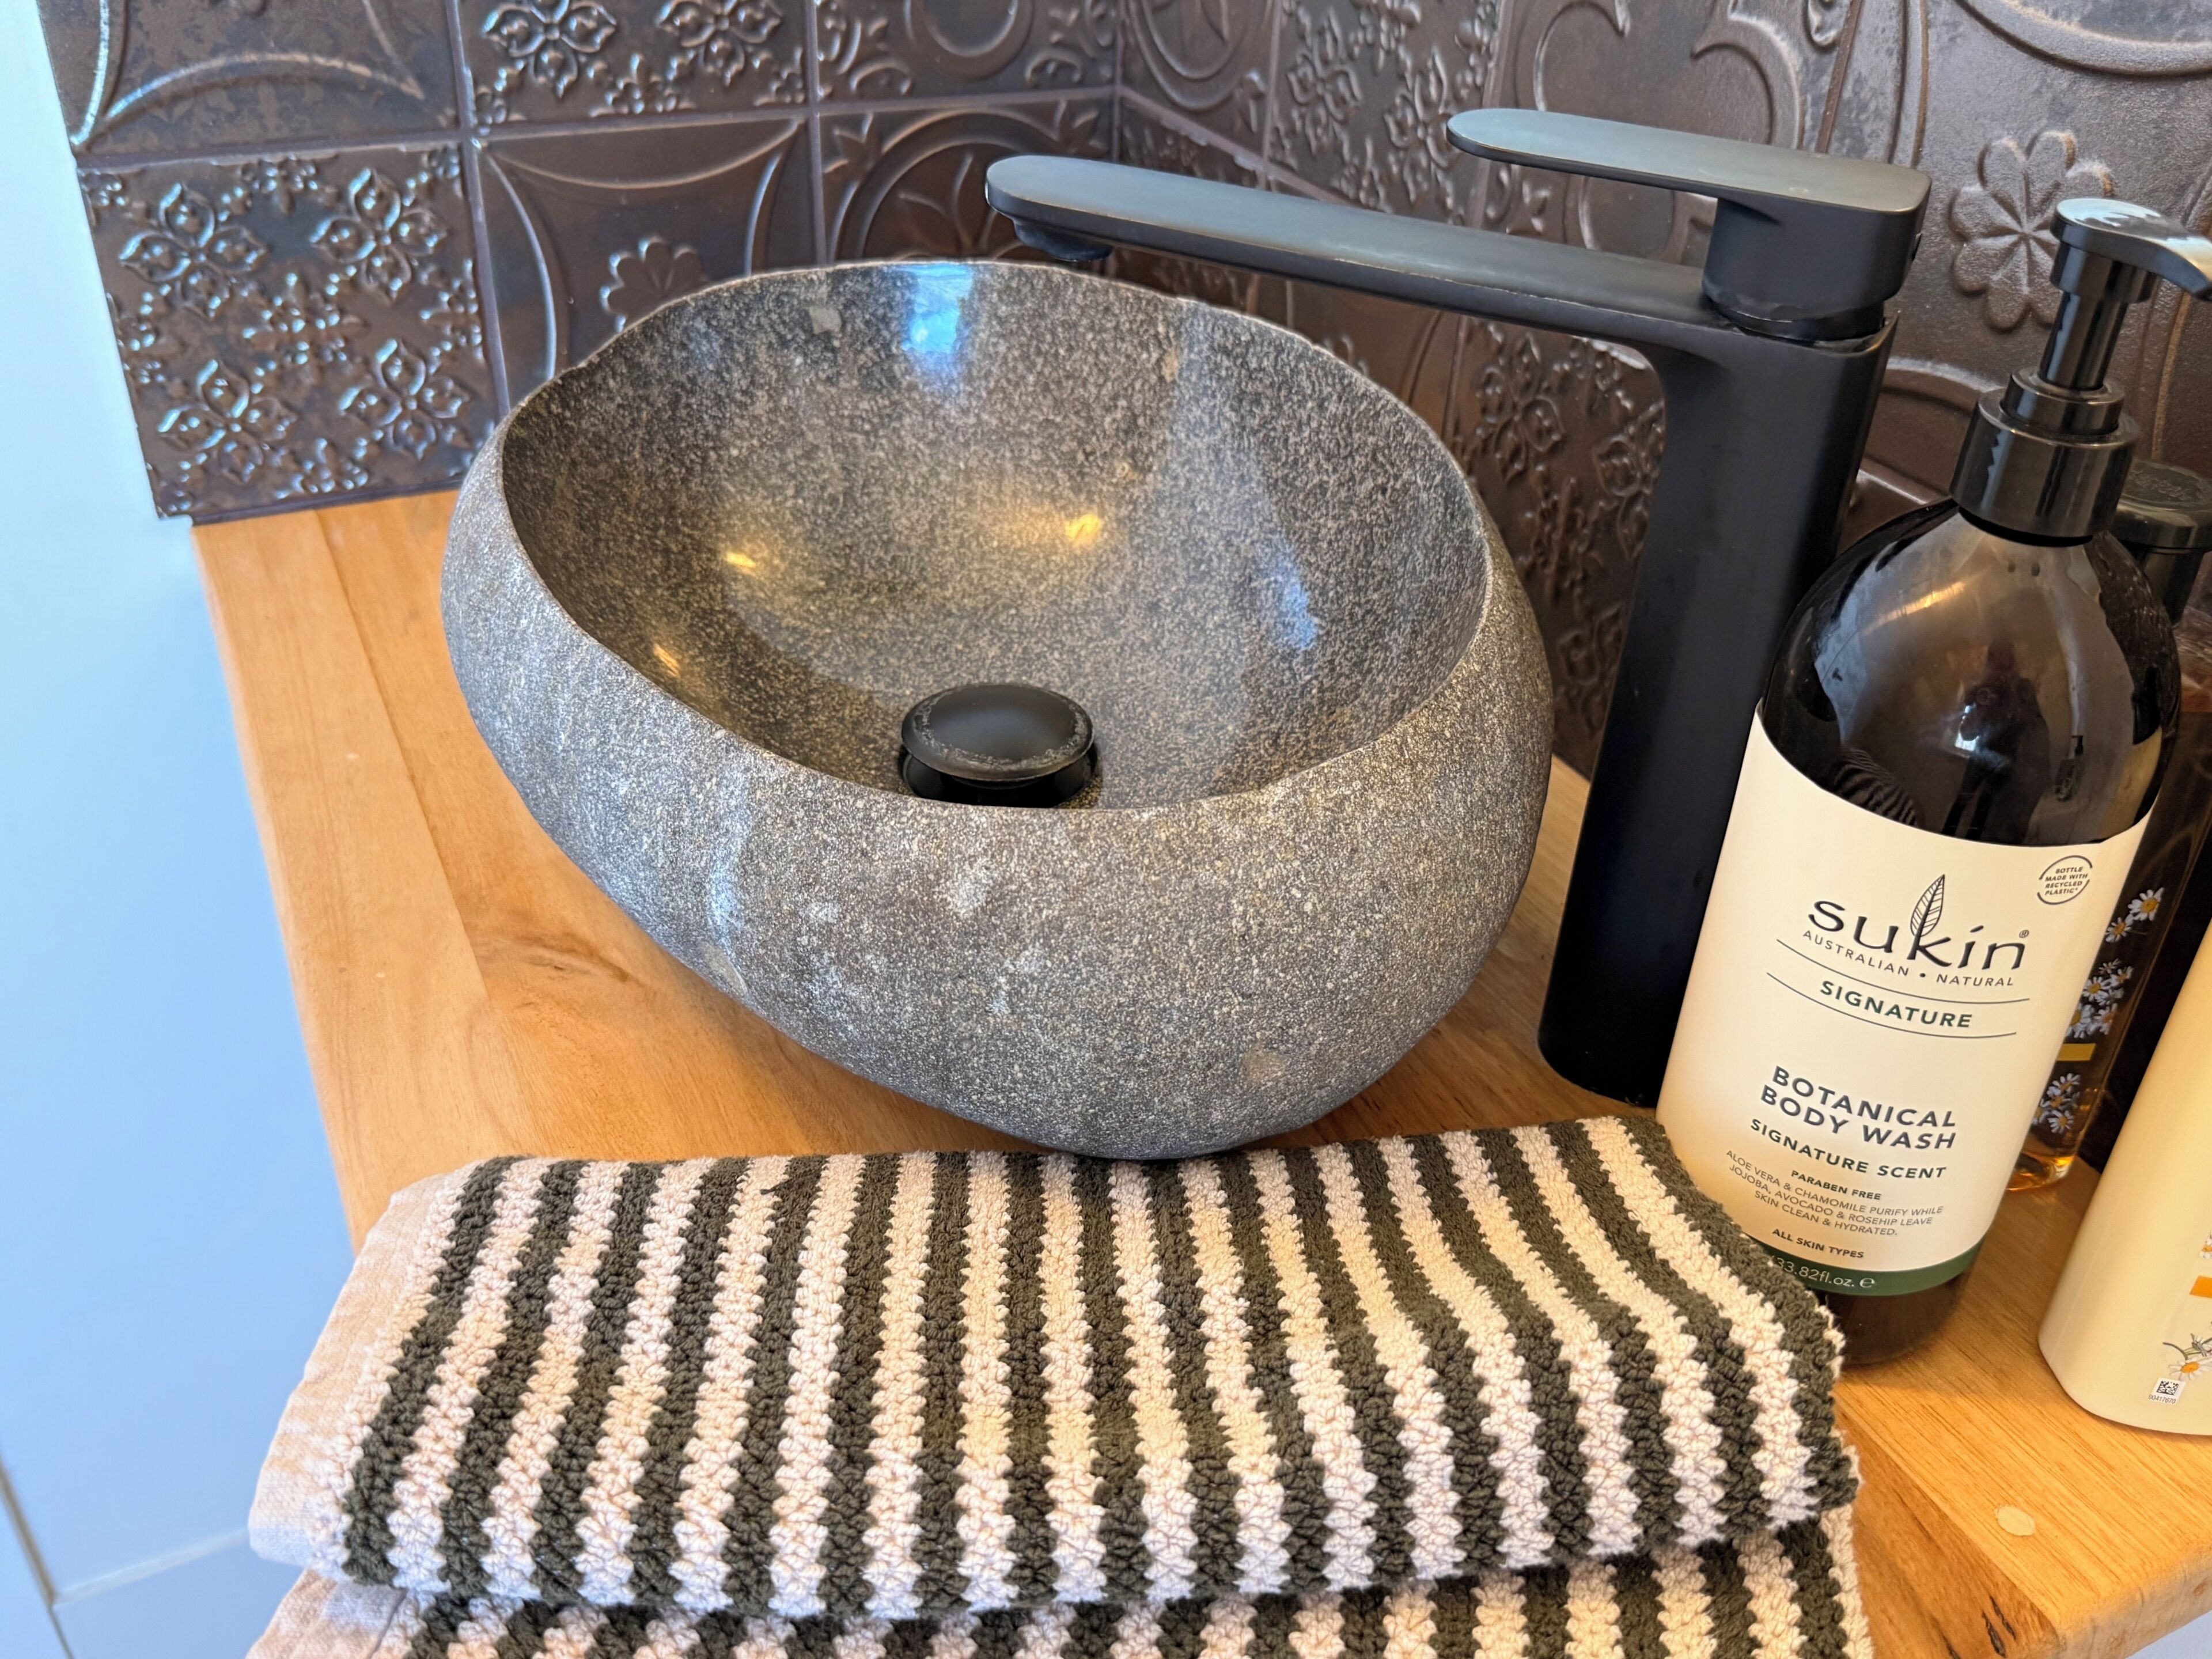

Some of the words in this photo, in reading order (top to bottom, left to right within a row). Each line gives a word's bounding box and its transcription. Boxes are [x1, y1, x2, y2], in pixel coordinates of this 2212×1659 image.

[1803, 930, 1909, 976] AUSTRALIAN
[1936, 973, 2014, 987] NATURAL
[1820, 981, 1972, 1028] SIGNATURE
[1760, 1085, 1849, 1134] BODY
[1862, 1124, 1956, 1149] WASH
[1772, 1066, 1956, 1127] BOTANICAL
[1751, 1119, 1869, 1173] SIGNATURE
[1877, 1165, 1946, 1179] SCENT
[1726, 1150, 1752, 1171] ALOE
[1755, 1166, 1780, 1186] VERA
[1783, 1183, 1791, 1191] &
[1795, 1187, 1866, 1213] CHAMOMILE
[1869, 1206, 1908, 1217] PURIFY
[1911, 1206, 1944, 1216] WHILE
[1729, 1164, 1771, 1194] JOJOBA,
[1775, 1190, 1833, 1216] AVOCADO
[1849, 1214, 1897, 1225] ROSEHIP
[1900, 1217, 1933, 1226] LEAVE
[1791, 1170, 1848, 1194] PARABEN
[1851, 1189, 1882, 1200] FREE
[1754, 1190, 1779, 1208] SKIN
[1782, 1204, 1819, 1223] CLEAN
[1834, 1221, 1898, 1236] HYDRATED.
[1772, 1228, 1793, 1242] ALL
[1796, 1238, 1824, 1251] SKIN
[1828, 1246, 1864, 1258] TYPES
